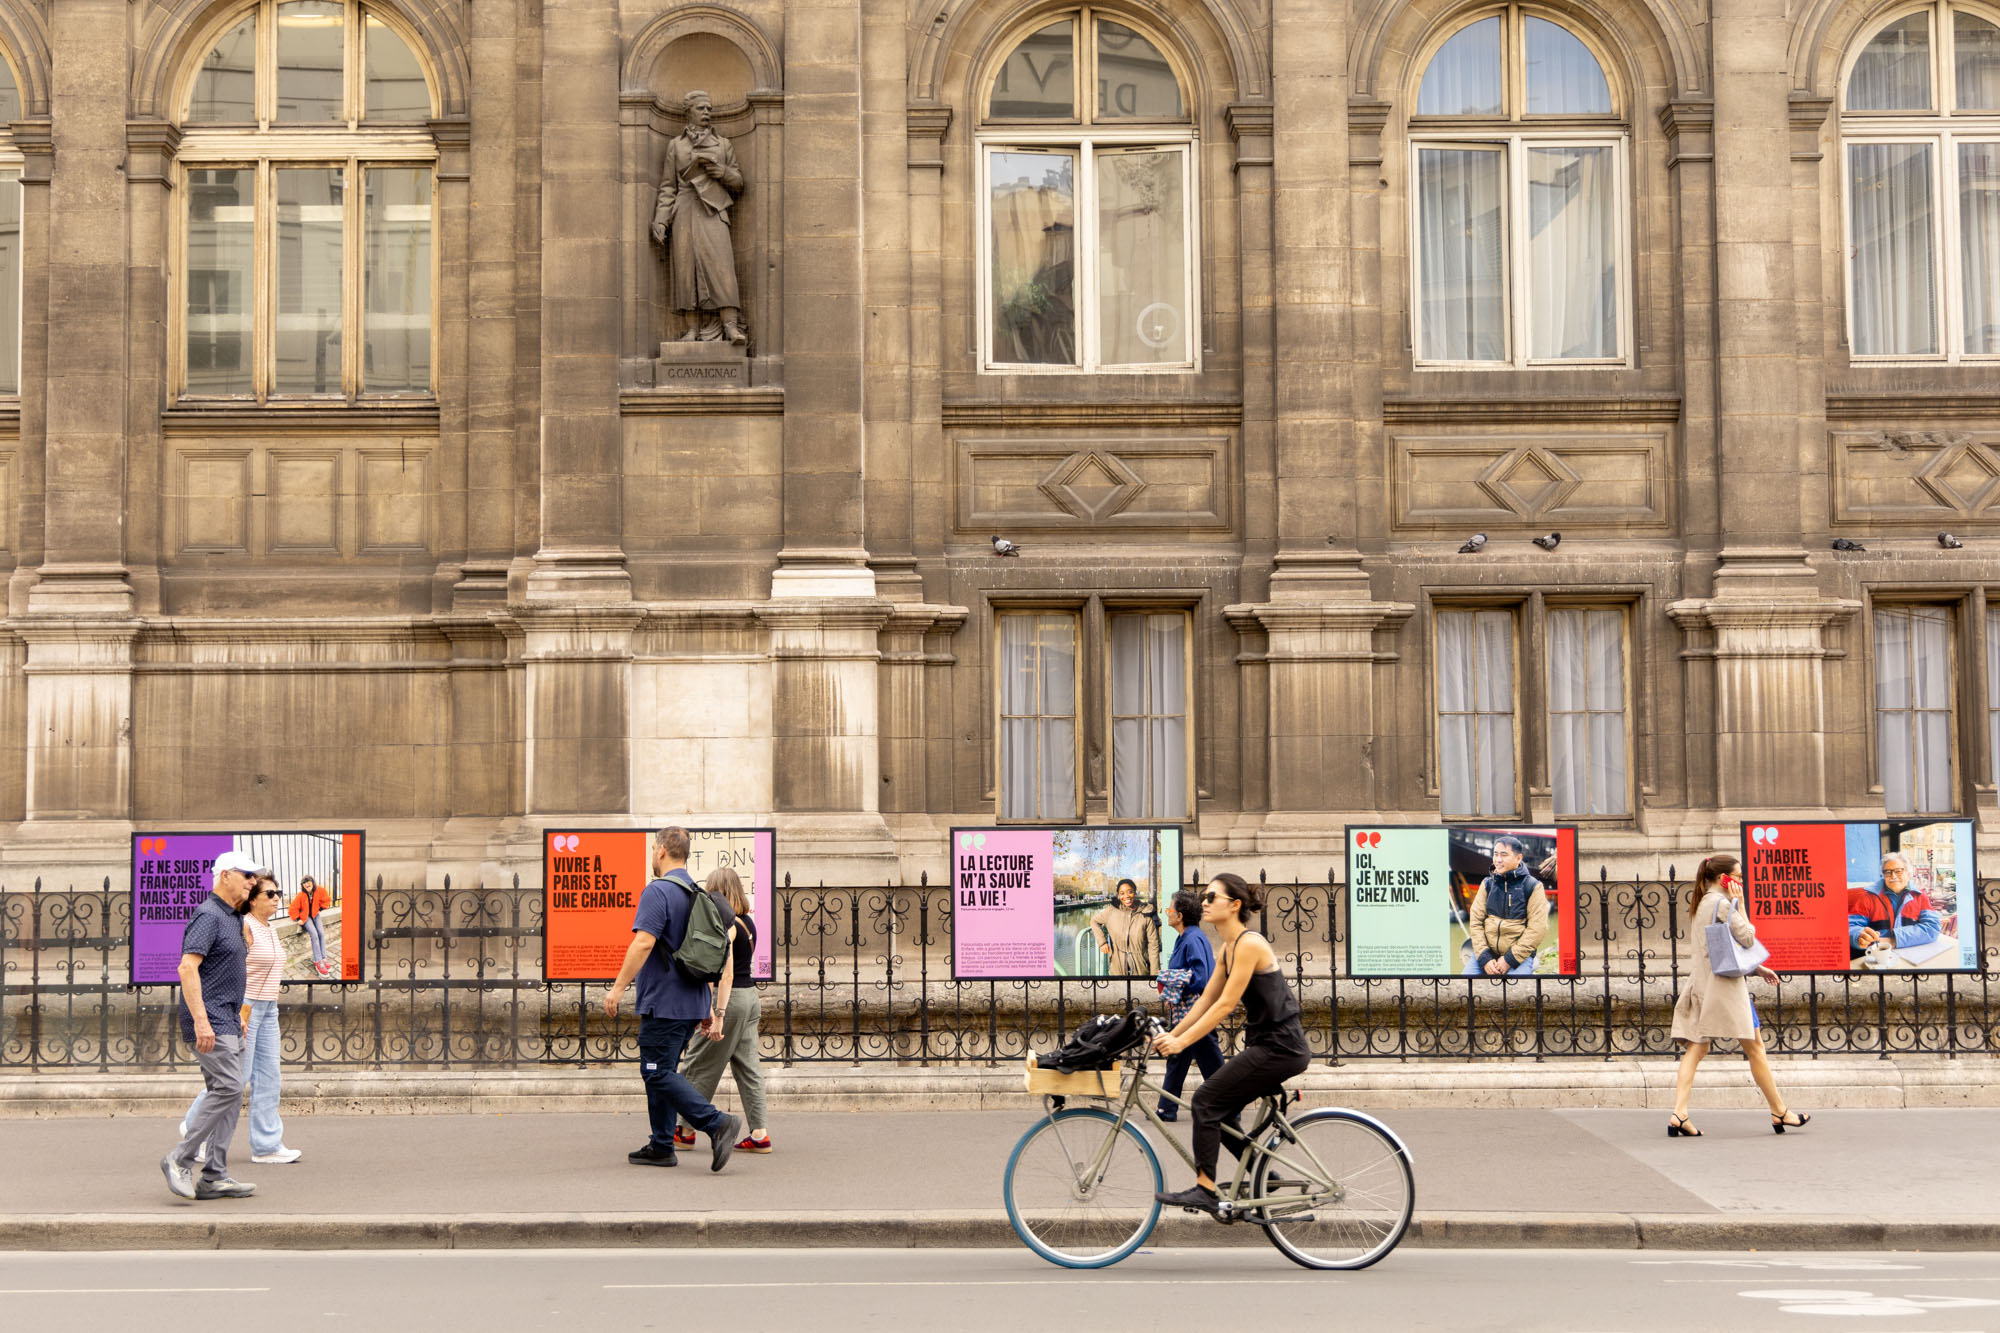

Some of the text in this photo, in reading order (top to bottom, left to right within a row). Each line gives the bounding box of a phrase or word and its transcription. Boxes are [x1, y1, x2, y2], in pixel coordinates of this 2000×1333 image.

[553, 857, 590, 872] VIVRE
[960, 855, 1034, 871] LA LECTURE
[1356, 853, 1376, 870] ICI,
[1753, 849, 1809, 865] J'HABITE
[140, 860, 154, 874] JE
[157, 860, 171, 874] NE
[174, 860, 199, 874] SUIS
[1754, 864, 1812, 882] LA MÊME
[140, 875, 205, 894] FRANÇAISE,
[553, 874, 617, 890] PARIS EST
[960, 870, 1031, 889] M'A SAUVÉ
[1356, 870, 1429, 886] JE ME SENS
[140, 891, 170, 905] MAIS
[173, 891, 186, 905] JE
[960, 890, 976, 906] LA
[979, 890, 999, 906] VIE
[1356, 887, 1420, 903] CHEZ MOI.
[1754, 883, 1825, 899] RUE DEPUIS
[553, 892, 636, 908] UNE CHANCE.
[1755, 900, 1804, 916] 78 ANS.
[140, 906, 197, 920] PARISIEN
